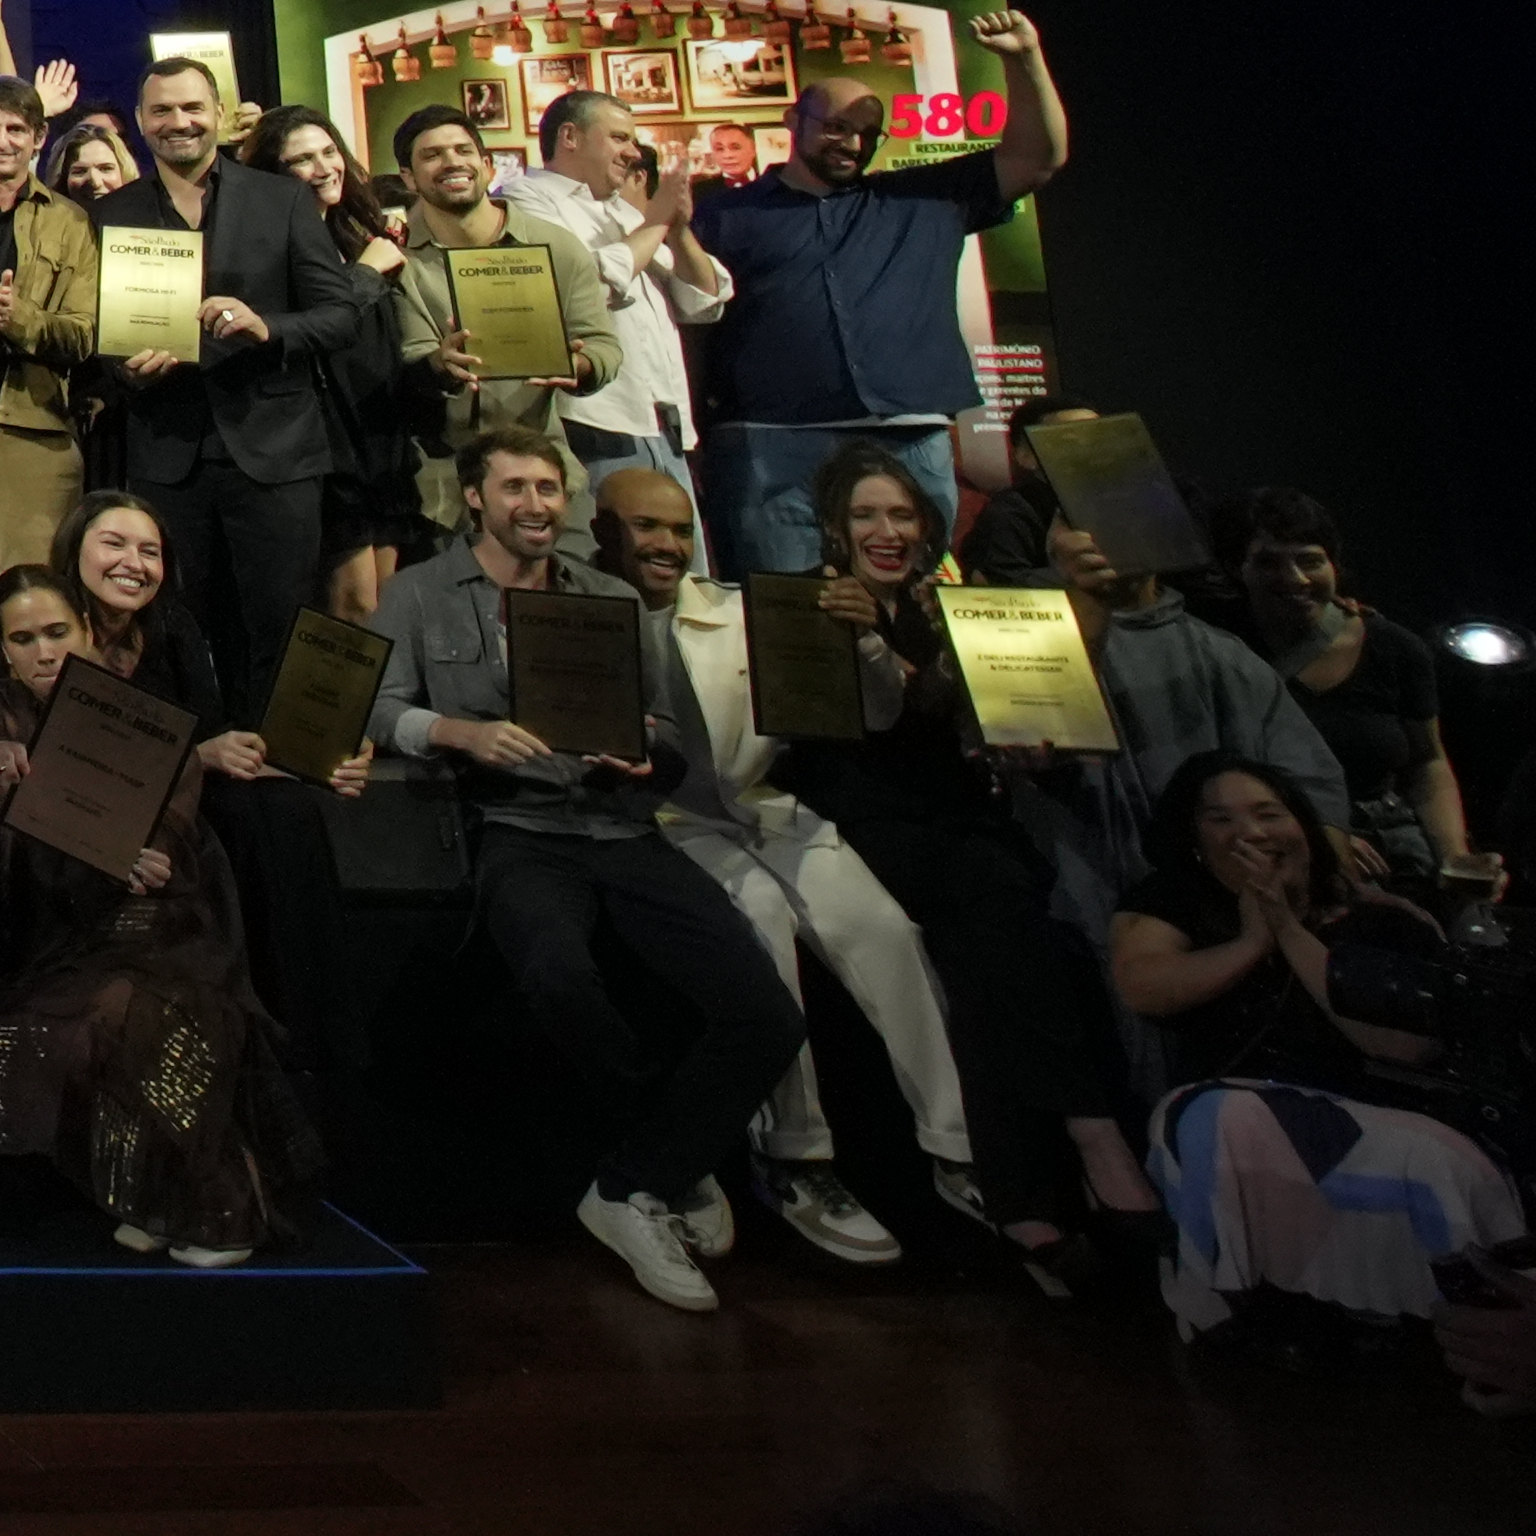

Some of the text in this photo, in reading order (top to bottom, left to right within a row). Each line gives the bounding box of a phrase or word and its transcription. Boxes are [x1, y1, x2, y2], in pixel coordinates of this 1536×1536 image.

[888, 90, 1008, 139] 580
[109, 244, 150, 255] COMER
[160, 248, 195, 259] BEBER
[458, 267, 500, 277] COMER
[509, 265, 544, 275] BEBER
[953, 608, 1006, 620] COMER
[1020, 610, 1063, 622] BEBER
